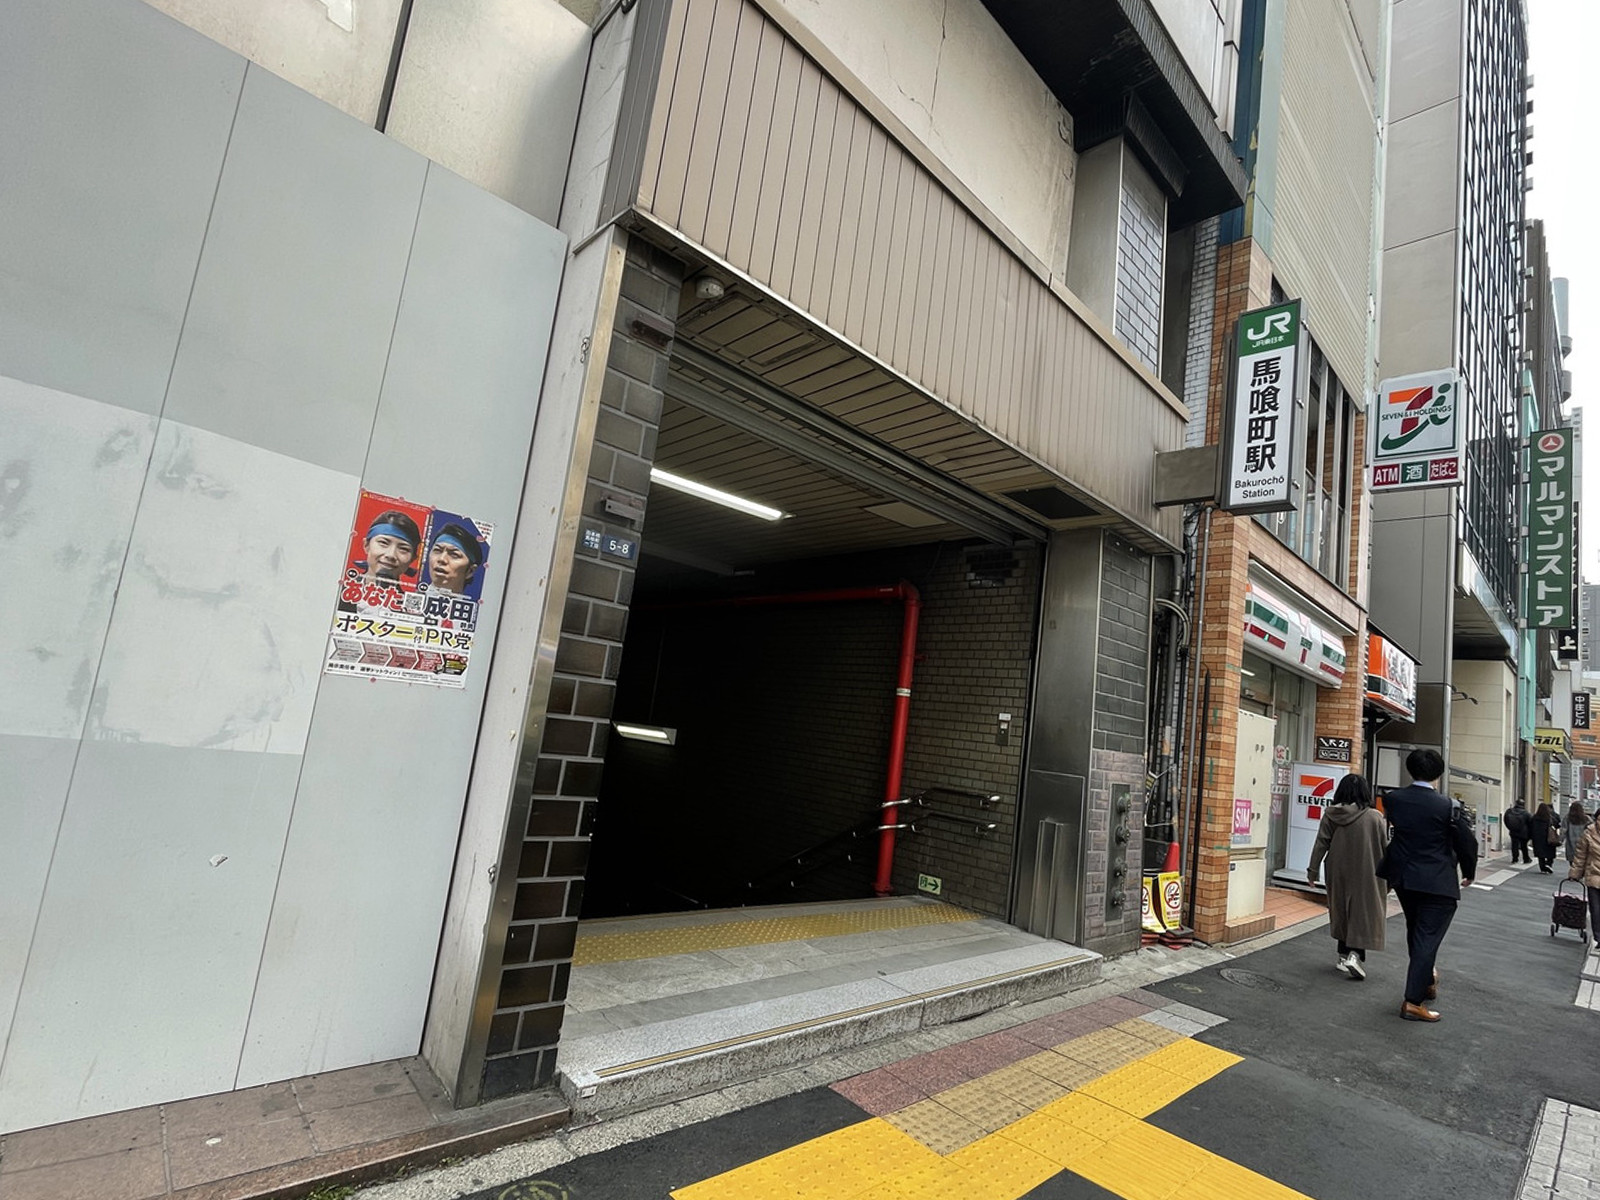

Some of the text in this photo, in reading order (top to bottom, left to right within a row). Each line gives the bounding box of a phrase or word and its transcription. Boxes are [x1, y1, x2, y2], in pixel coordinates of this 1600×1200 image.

[1247, 311, 1292, 341] JR
[1244, 356, 1282, 473] 馬喰町駅
[1413, 405, 1453, 416] HOLDINGS
[1374, 461, 1457, 483] ATM 酒 たばこ
[1242, 488, 1276, 499] Station
[609, 540, 629, 554] 5-8
[1535, 456, 1565, 626] マルマンストア
[342, 580, 404, 611] あなた
